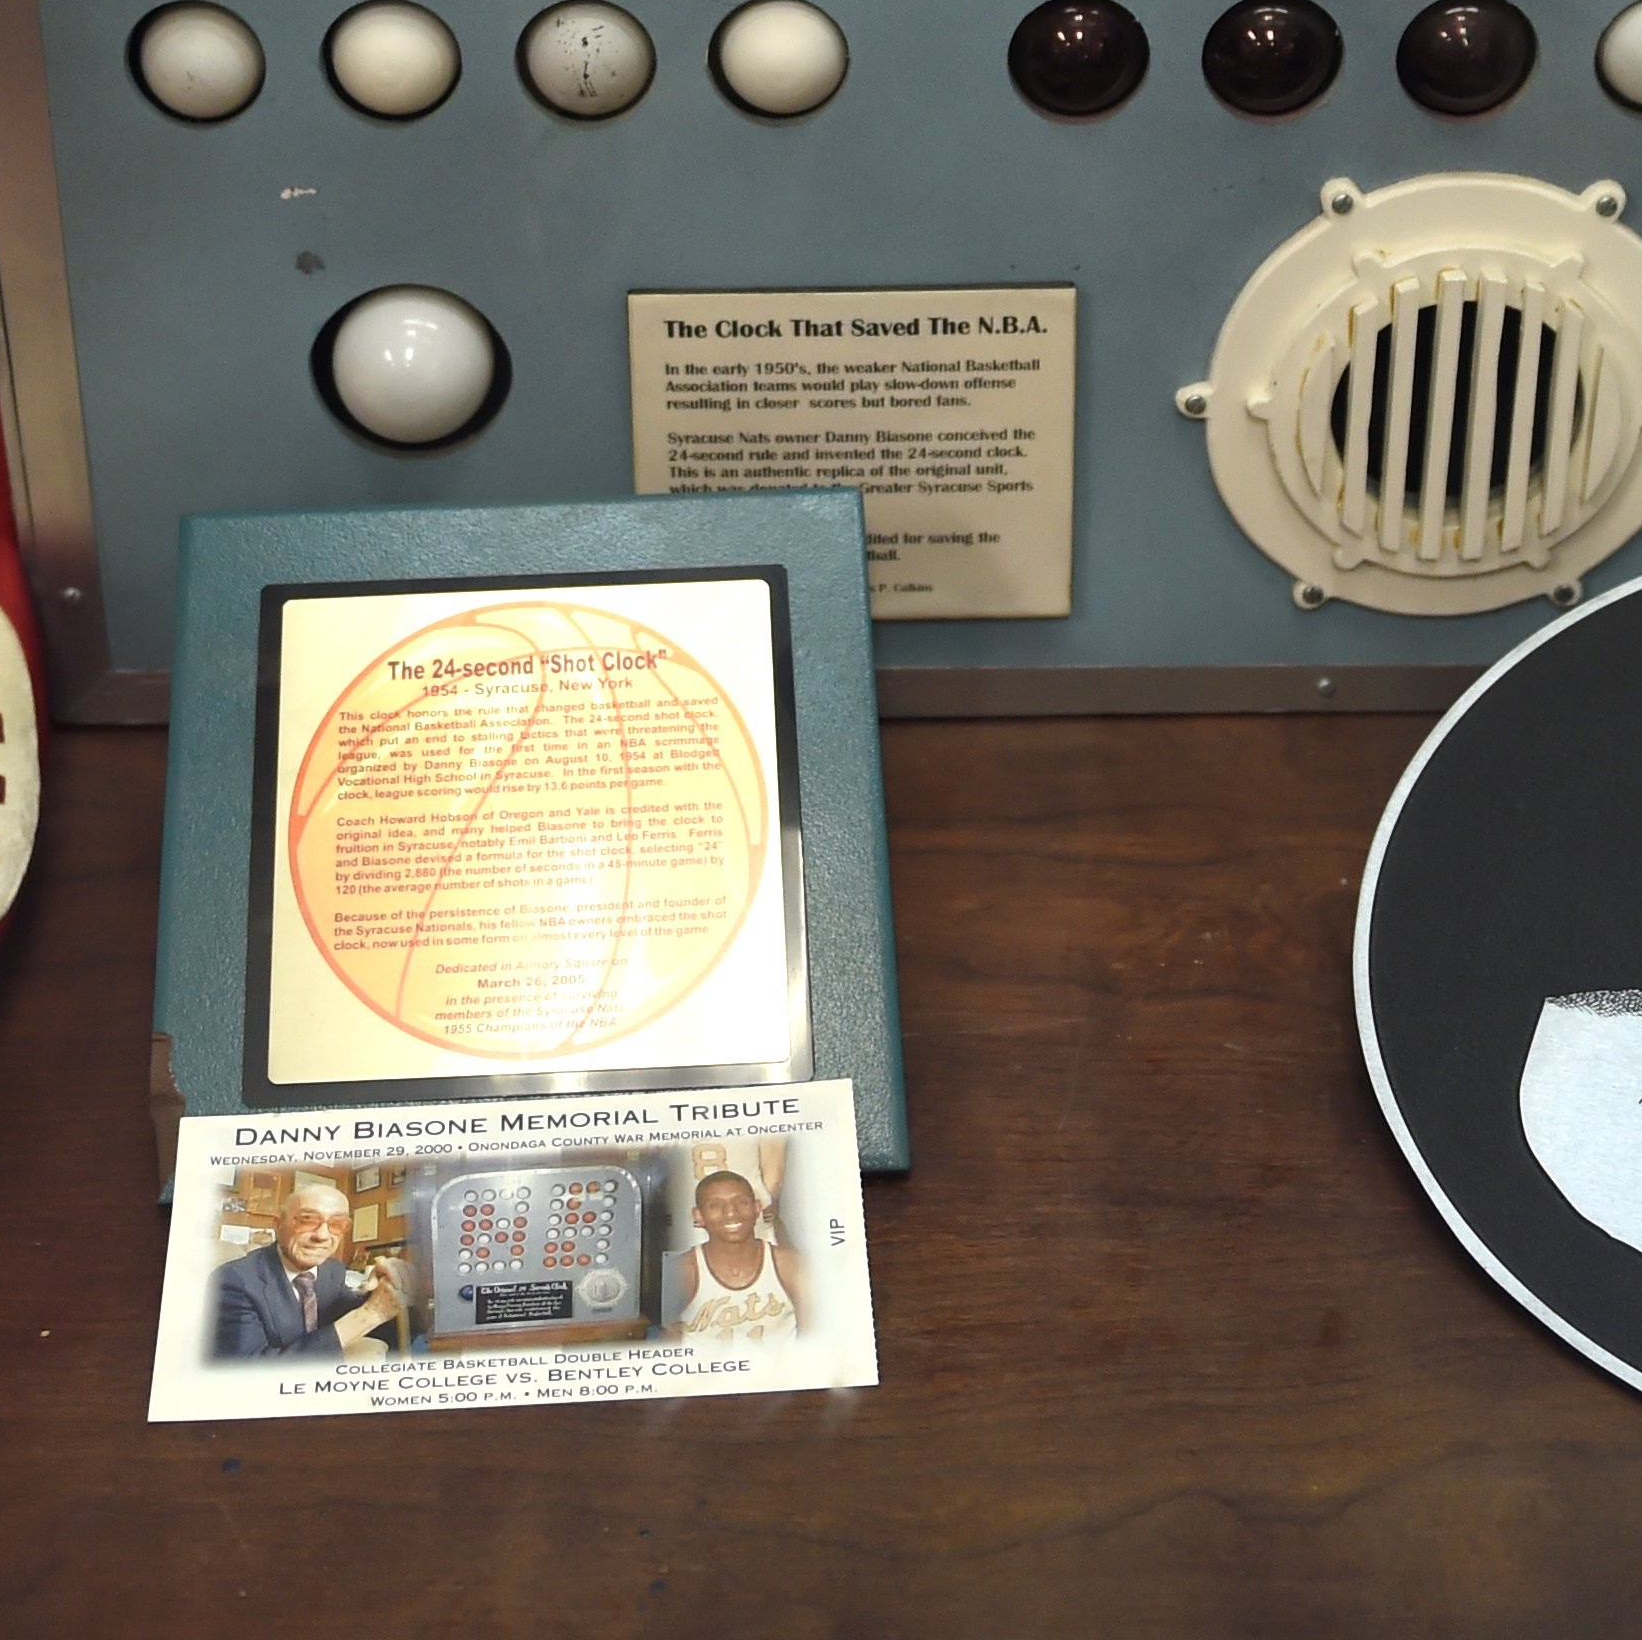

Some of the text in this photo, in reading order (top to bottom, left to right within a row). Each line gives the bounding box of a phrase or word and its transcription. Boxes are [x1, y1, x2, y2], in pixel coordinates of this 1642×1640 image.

[664, 316, 1047, 338] The Clock That Saved The N.B.A.
[665, 359, 1040, 377] In the early 1950's, the weaker National Basketball
[666, 377, 1016, 393] Association teams would play slow-down offense
[667, 395, 971, 412] resulting in closer scores but bored fans.
[667, 428, 1035, 446] Syracuse Nats owner Danny Biasone conceived the
[669, 446, 1027, 461] 24-second rule and invented the 24-second clock.
[670, 466, 699, 478] This
[704, 467, 716, 478] is
[720, 469, 738, 478] an
[744, 466, 811, 478] authentic
[816, 466, 865, 480] replica
[870, 465, 884, 477] of
[889, 465, 911, 476] the
[915, 464, 971, 479] original
[669, 483, 712, 494] which
[859, 482, 914, 495] Greater
[918, 481, 982, 496] Syracuse
[988, 479, 1034, 494] Sports
[904, 532, 923, 545] for
[928, 532, 974, 547] saving
[979, 531, 1001, 544] the
[388, 661, 425, 680] The
[432, 655, 534, 679] 24-second
[422, 684, 458, 697] 1954
[475, 682, 553, 698] Syracuse,
[559, 679, 592, 691] New
[598, 677, 633, 690] York
[337, 801, 723, 827] Coach Howard Hobson of Oregon and Yale is credited with the
[236, 1099, 799, 1145] DANNY BIASONE MEMORIAL TRIBUTE
[211, 1122, 822, 1165] WEDNESDAY, NOVEMBER 29, 2000 ONONDAGA COUNTY WAR MEMORIAL AT ONCENTER
[829, 1218, 846, 1247] VIP
[681, 1291, 786, 1333] Nats
[336, 1348, 693, 1375] COLLEGIATE BASKETBALL DOUBLE HEADER
[280, 1360, 750, 1394] LE MOYNE COLLEGE VS. BENTLEY COLLEGE
[371, 1384, 657, 1406] WOMEN 5:00 P.M. MEN 8:00 P.M.
